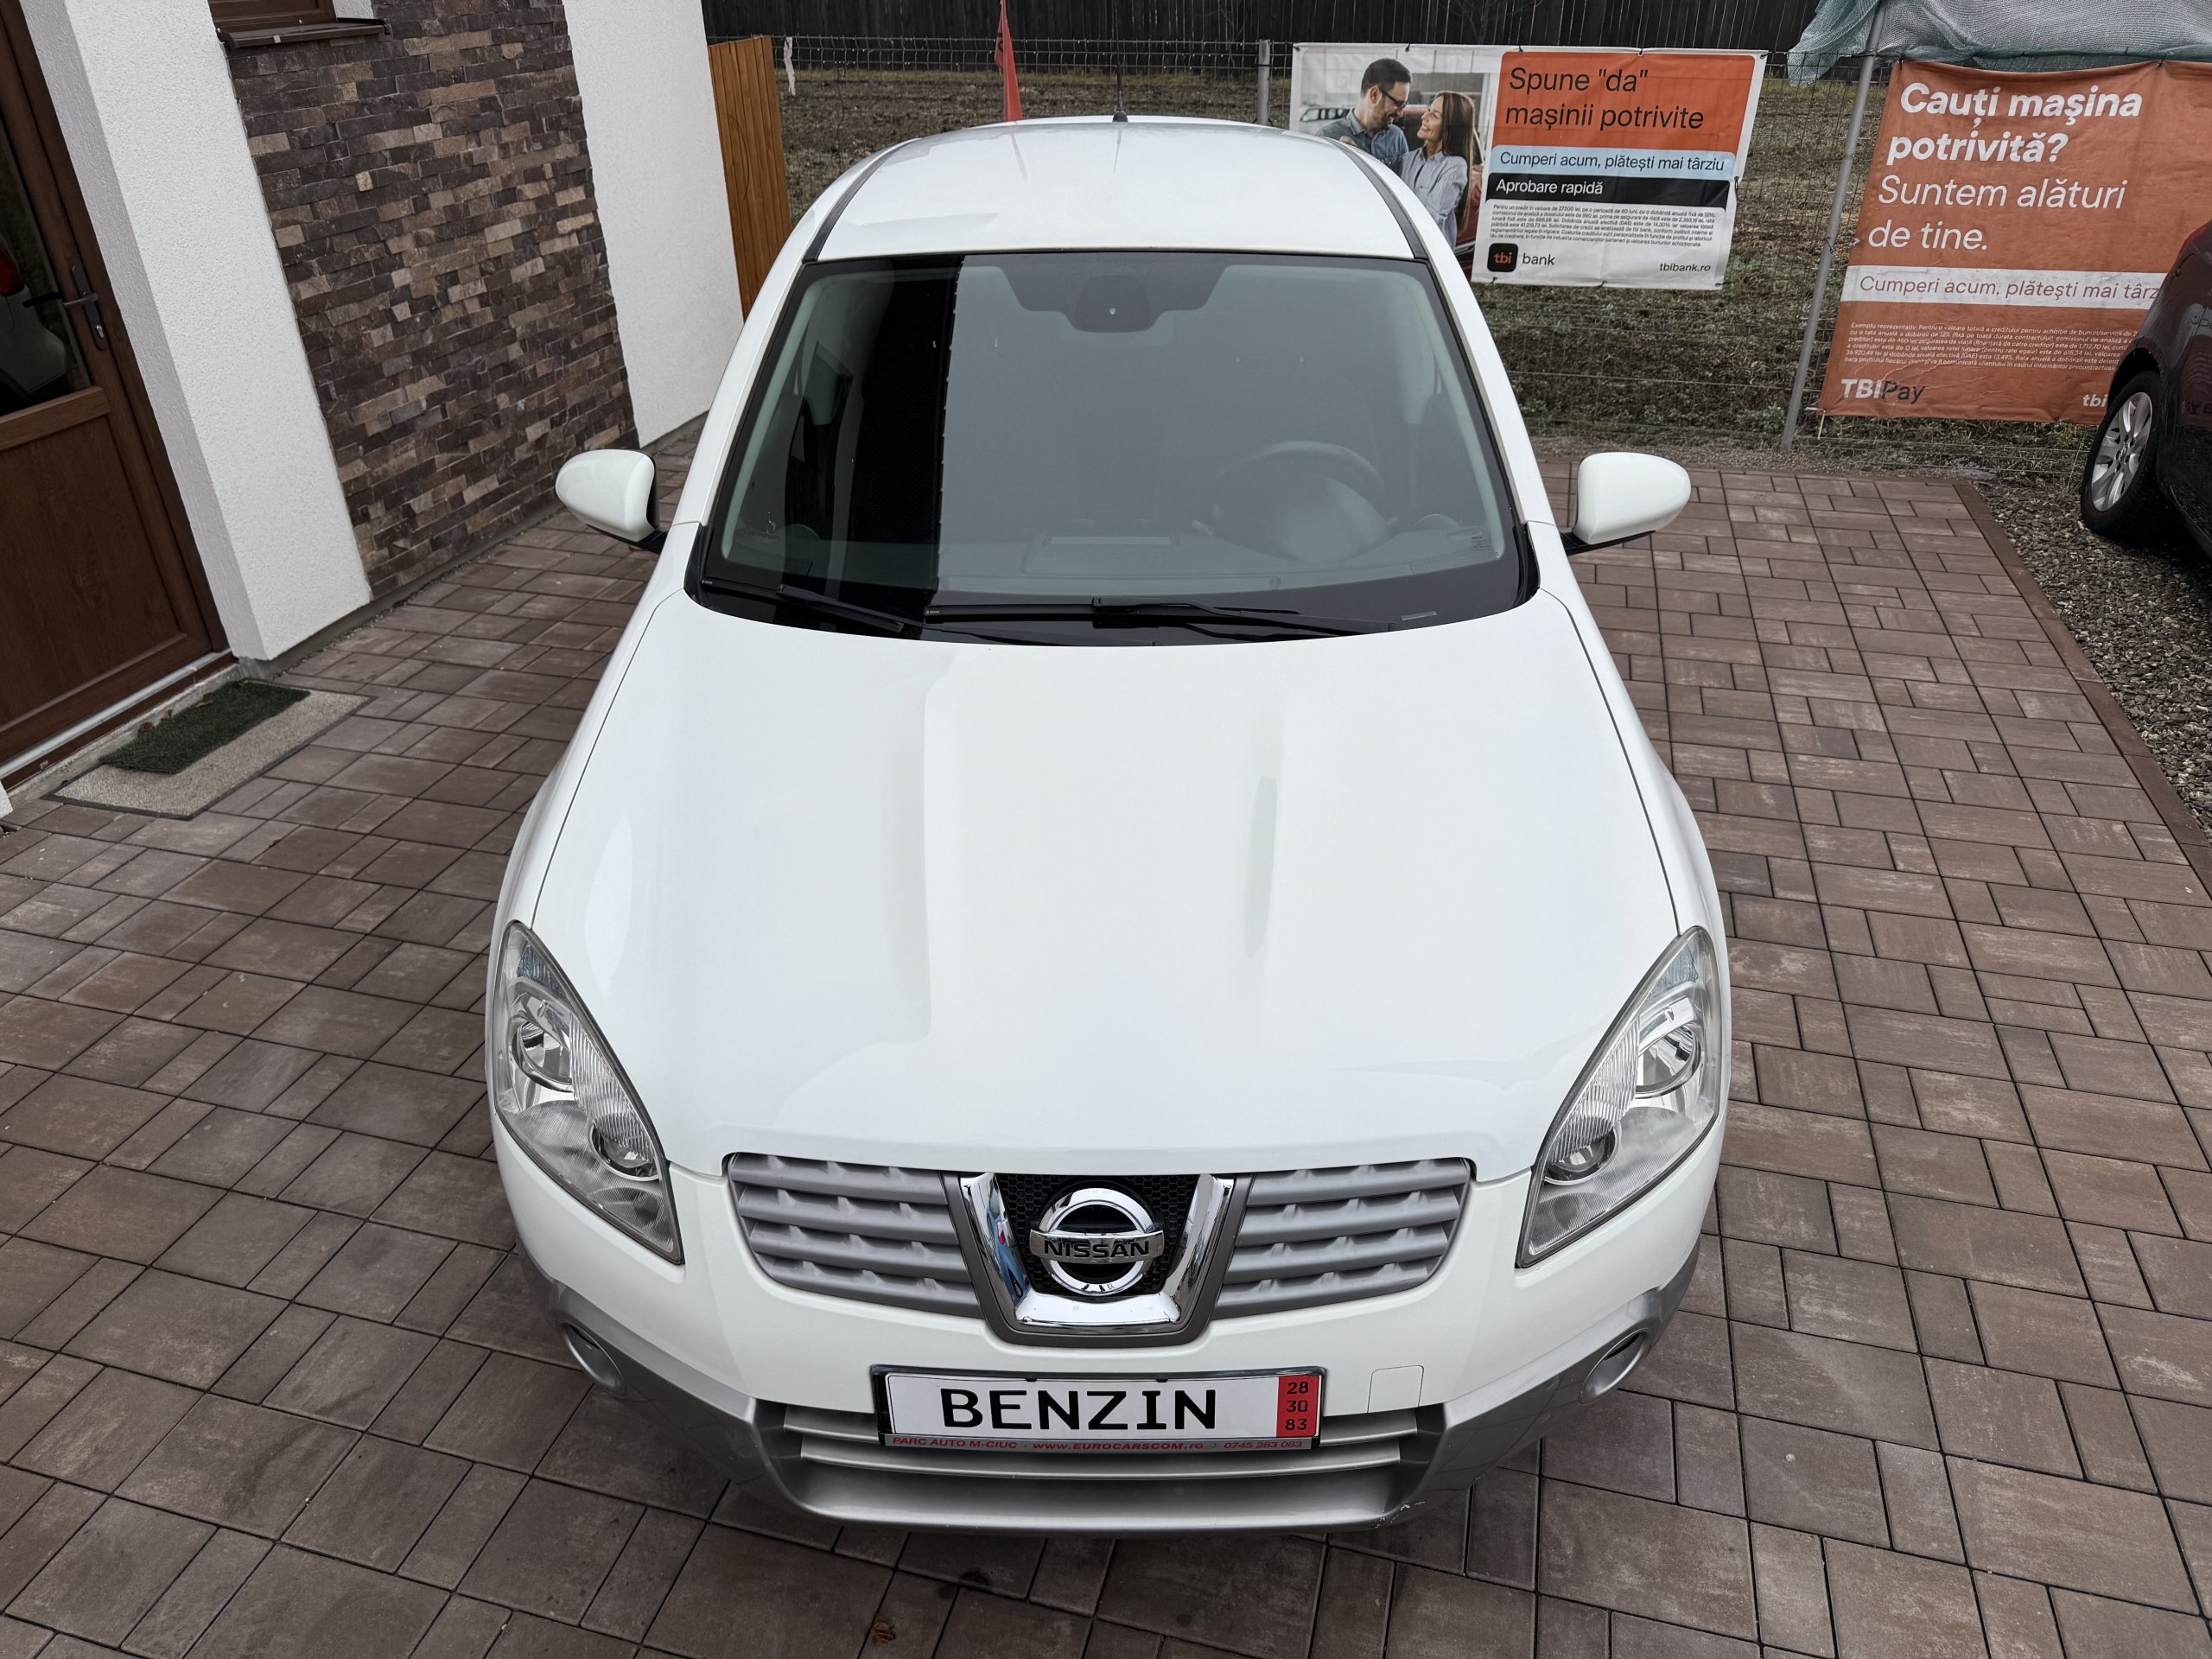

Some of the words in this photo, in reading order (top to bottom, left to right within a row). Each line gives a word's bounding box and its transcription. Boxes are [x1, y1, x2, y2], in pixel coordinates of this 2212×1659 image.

[1509, 67, 1591, 95] Spune
[1599, 68, 1649, 92] "da"
[1901, 82, 2002, 128] Cauți
[1505, 103, 1595, 131] mașinii
[1599, 105, 1705, 131] potrivite
[1885, 130, 2069, 167] potrivită?
[1500, 151, 1557, 168] Cumperi
[1560, 156, 1601, 169] acum,
[1605, 154, 1656, 172] plătești
[1657, 156, 1684, 170] mai
[1687, 157, 1725, 172] târziu
[1496, 178, 1558, 194] Aprobare
[1560, 181, 1604, 195] rapidă
[1878, 175, 2006, 207] Suntem
[2017, 178, 2128, 210] alături
[1868, 219, 1910, 248] de
[1920, 221, 1987, 251] tine.
[1493, 252, 1512, 264] tbi
[1522, 252, 1555, 266] bank
[1659, 262, 1711, 272] tbibank.ro
[1859, 276, 1940, 296] Cumperi
[1944, 281, 1999, 296] acum,
[2082, 283, 2119, 298] mai
[2123, 283, 2159, 299] târz
[1840, 378, 1925, 404] TBIPay
[1044, 1241, 1150, 1258] NISSAN
[1287, 1381, 1309, 1395] 28
[941, 1389, 1217, 1430] BENZIN
[1286, 1400, 1309, 1413] 30
[1285, 1418, 1307, 1431] 83
[893, 1436, 926, 1446] PARC
[930, 1438, 966, 1447] AUTO
[969, 1440, 1018, 1449] M-CIUC
[1224, 1441, 1253, 1450] 0745
[1255, 1440, 1277, 1449] 283
